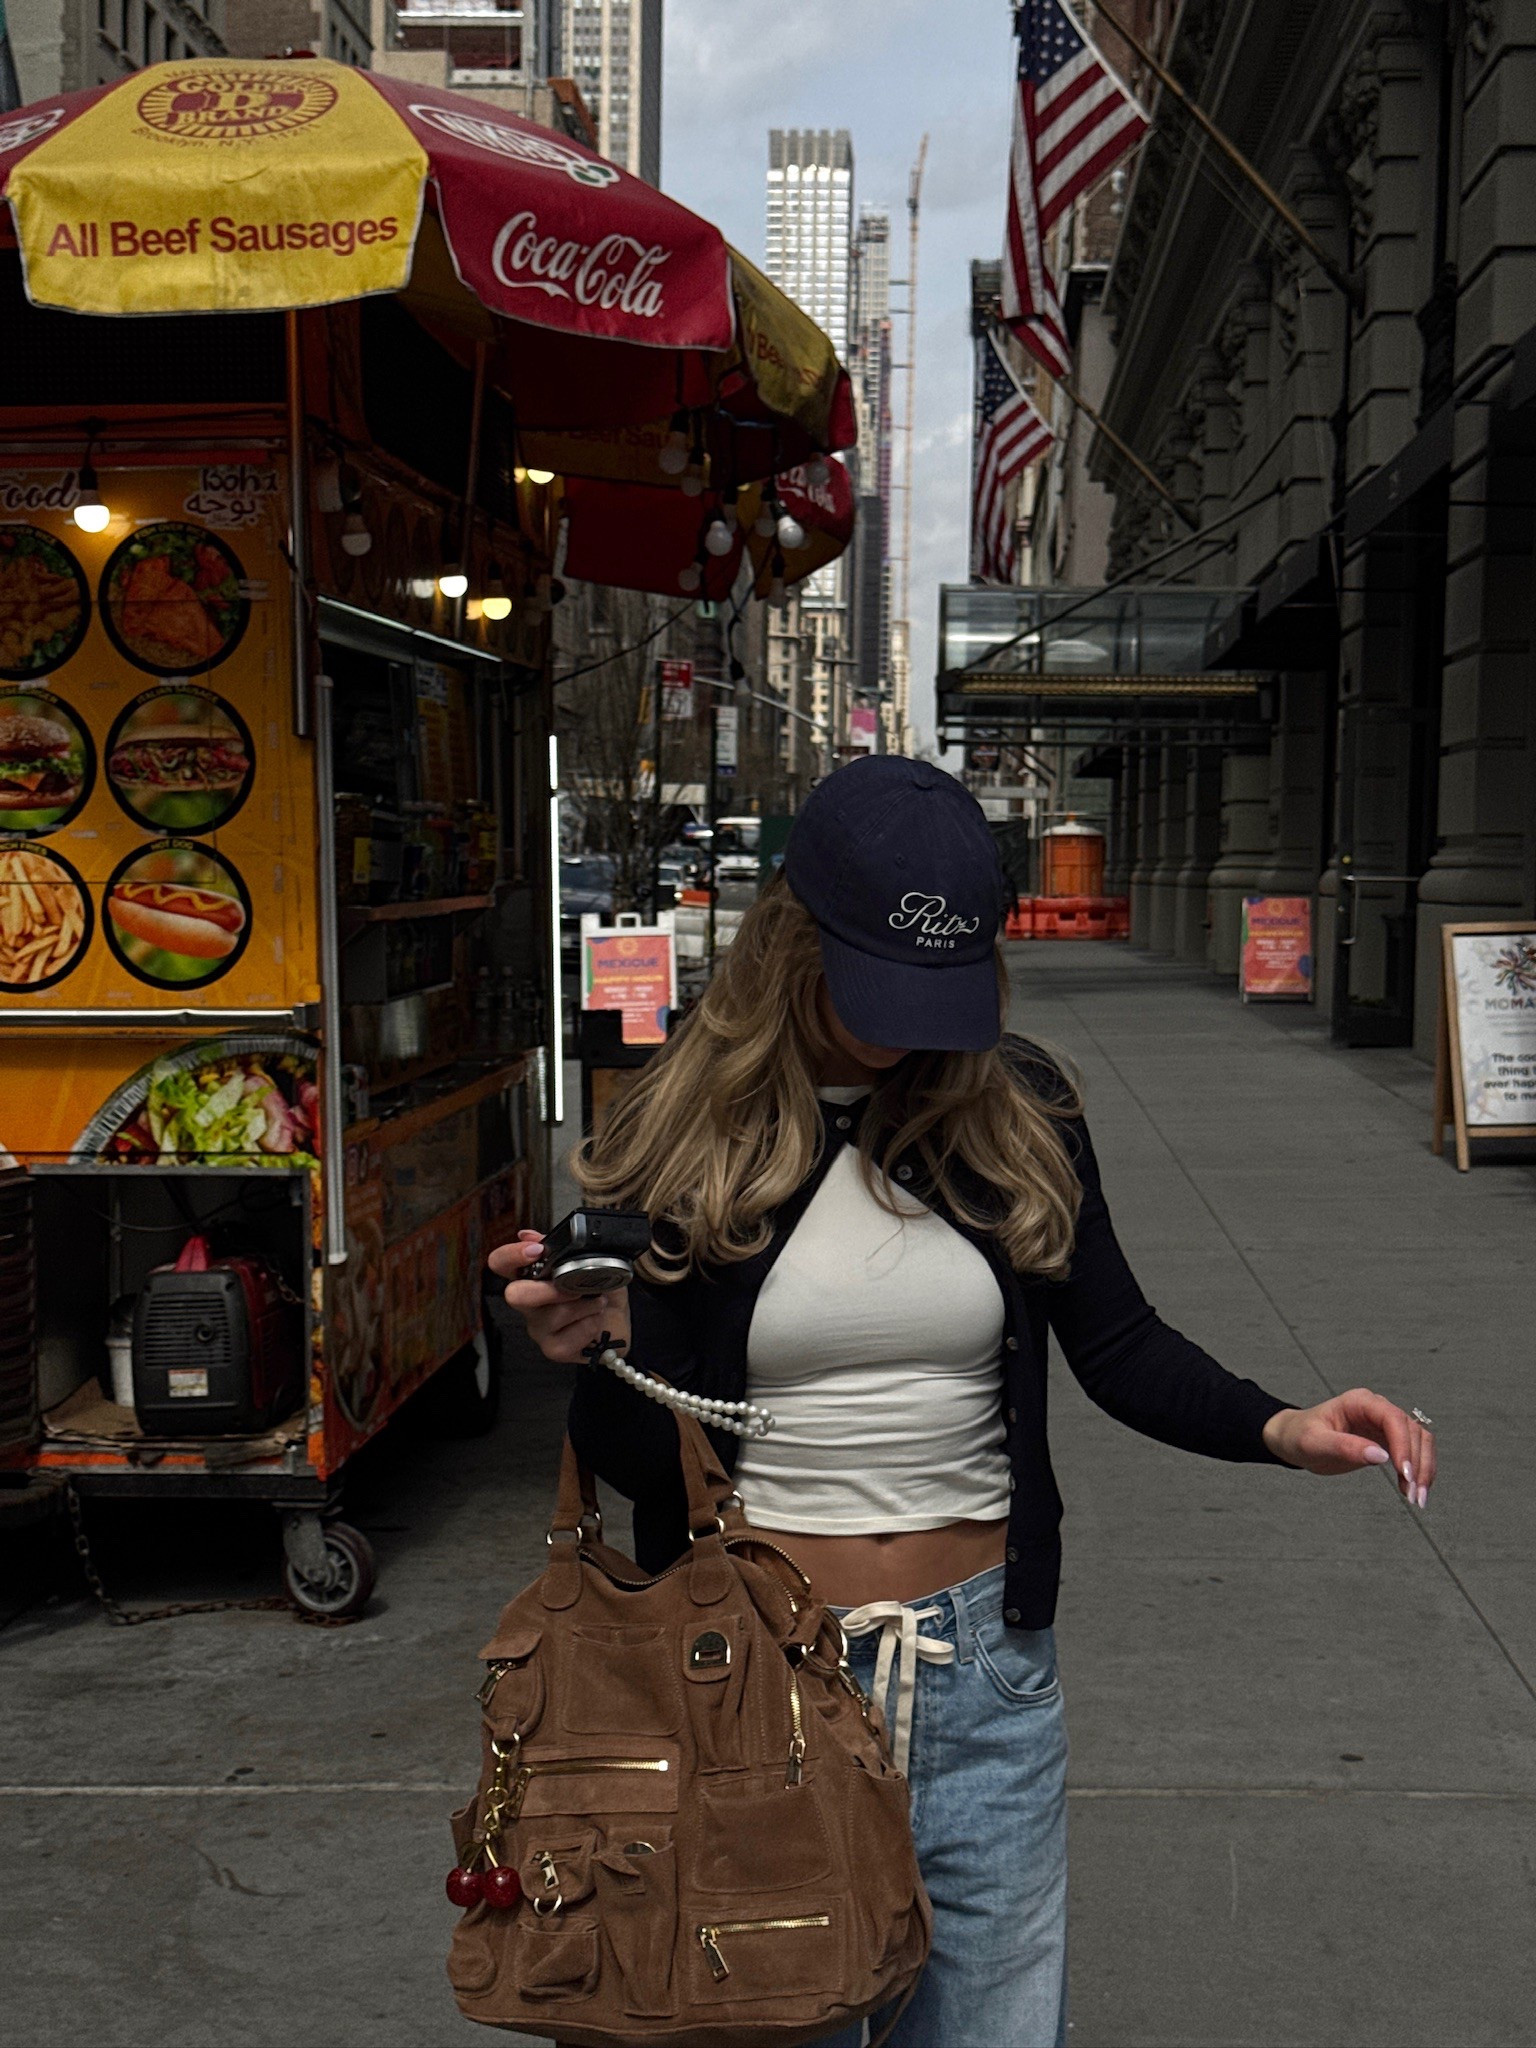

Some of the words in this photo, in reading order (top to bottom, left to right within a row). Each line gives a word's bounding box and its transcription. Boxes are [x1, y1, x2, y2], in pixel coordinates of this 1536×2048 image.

[175, 105, 290, 126] BRAND
[45, 222, 99, 257] All
[109, 217, 202, 257] Beef
[209, 216, 399, 257] Sausages
[492, 210, 673, 318] Coca-Cola
[889, 891, 980, 935] Ritz
[915, 936, 956, 949] PARIS
[1484, 996, 1536, 1010] MOMA
[1491, 1052, 1514, 1062] The
[1498, 1064, 1529, 1076] thing
[1513, 1078, 1536, 1091] hap
[1504, 1091, 1518, 1101] to
